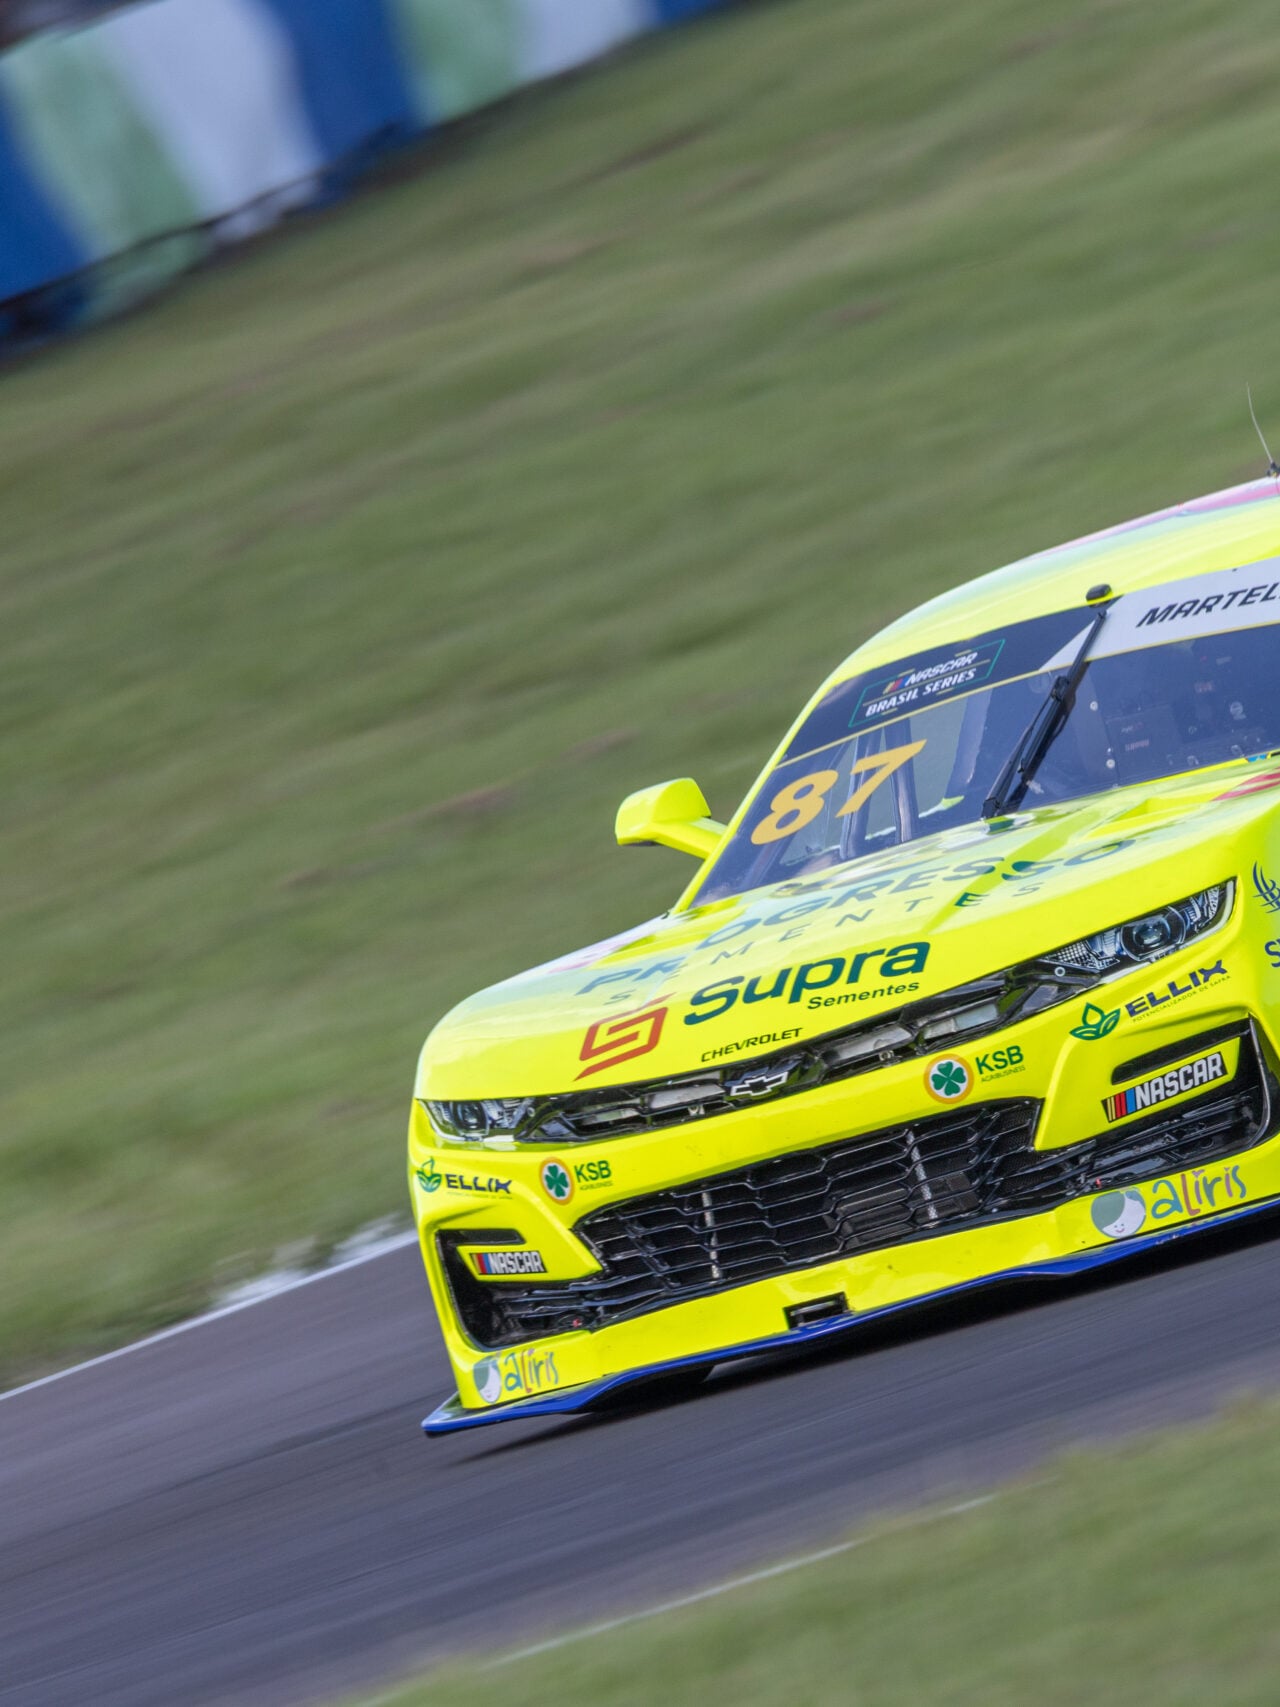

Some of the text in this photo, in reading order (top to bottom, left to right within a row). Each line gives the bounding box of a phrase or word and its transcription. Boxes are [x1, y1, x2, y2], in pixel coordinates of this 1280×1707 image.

[905, 651, 978, 687] NASCAR
[864, 667, 977, 718] BRASIL SERIES
[750, 738, 928, 846] 87
[574, 838, 1138, 996] PROGRESSO
[683, 940, 932, 1026] Supra
[806, 980, 920, 1011] Sementes
[1124, 958, 1229, 1018] ELLIX
[1199, 984, 1210, 993] DE
[700, 1026, 805, 1064] CHEVROLET
[975, 1045, 1025, 1075] KSB
[1135, 1053, 1225, 1109] NASCAR
[444, 1173, 513, 1195] ELLIX
[573, 1159, 613, 1184] KSB
[488, 1250, 545, 1275] NASCAR
